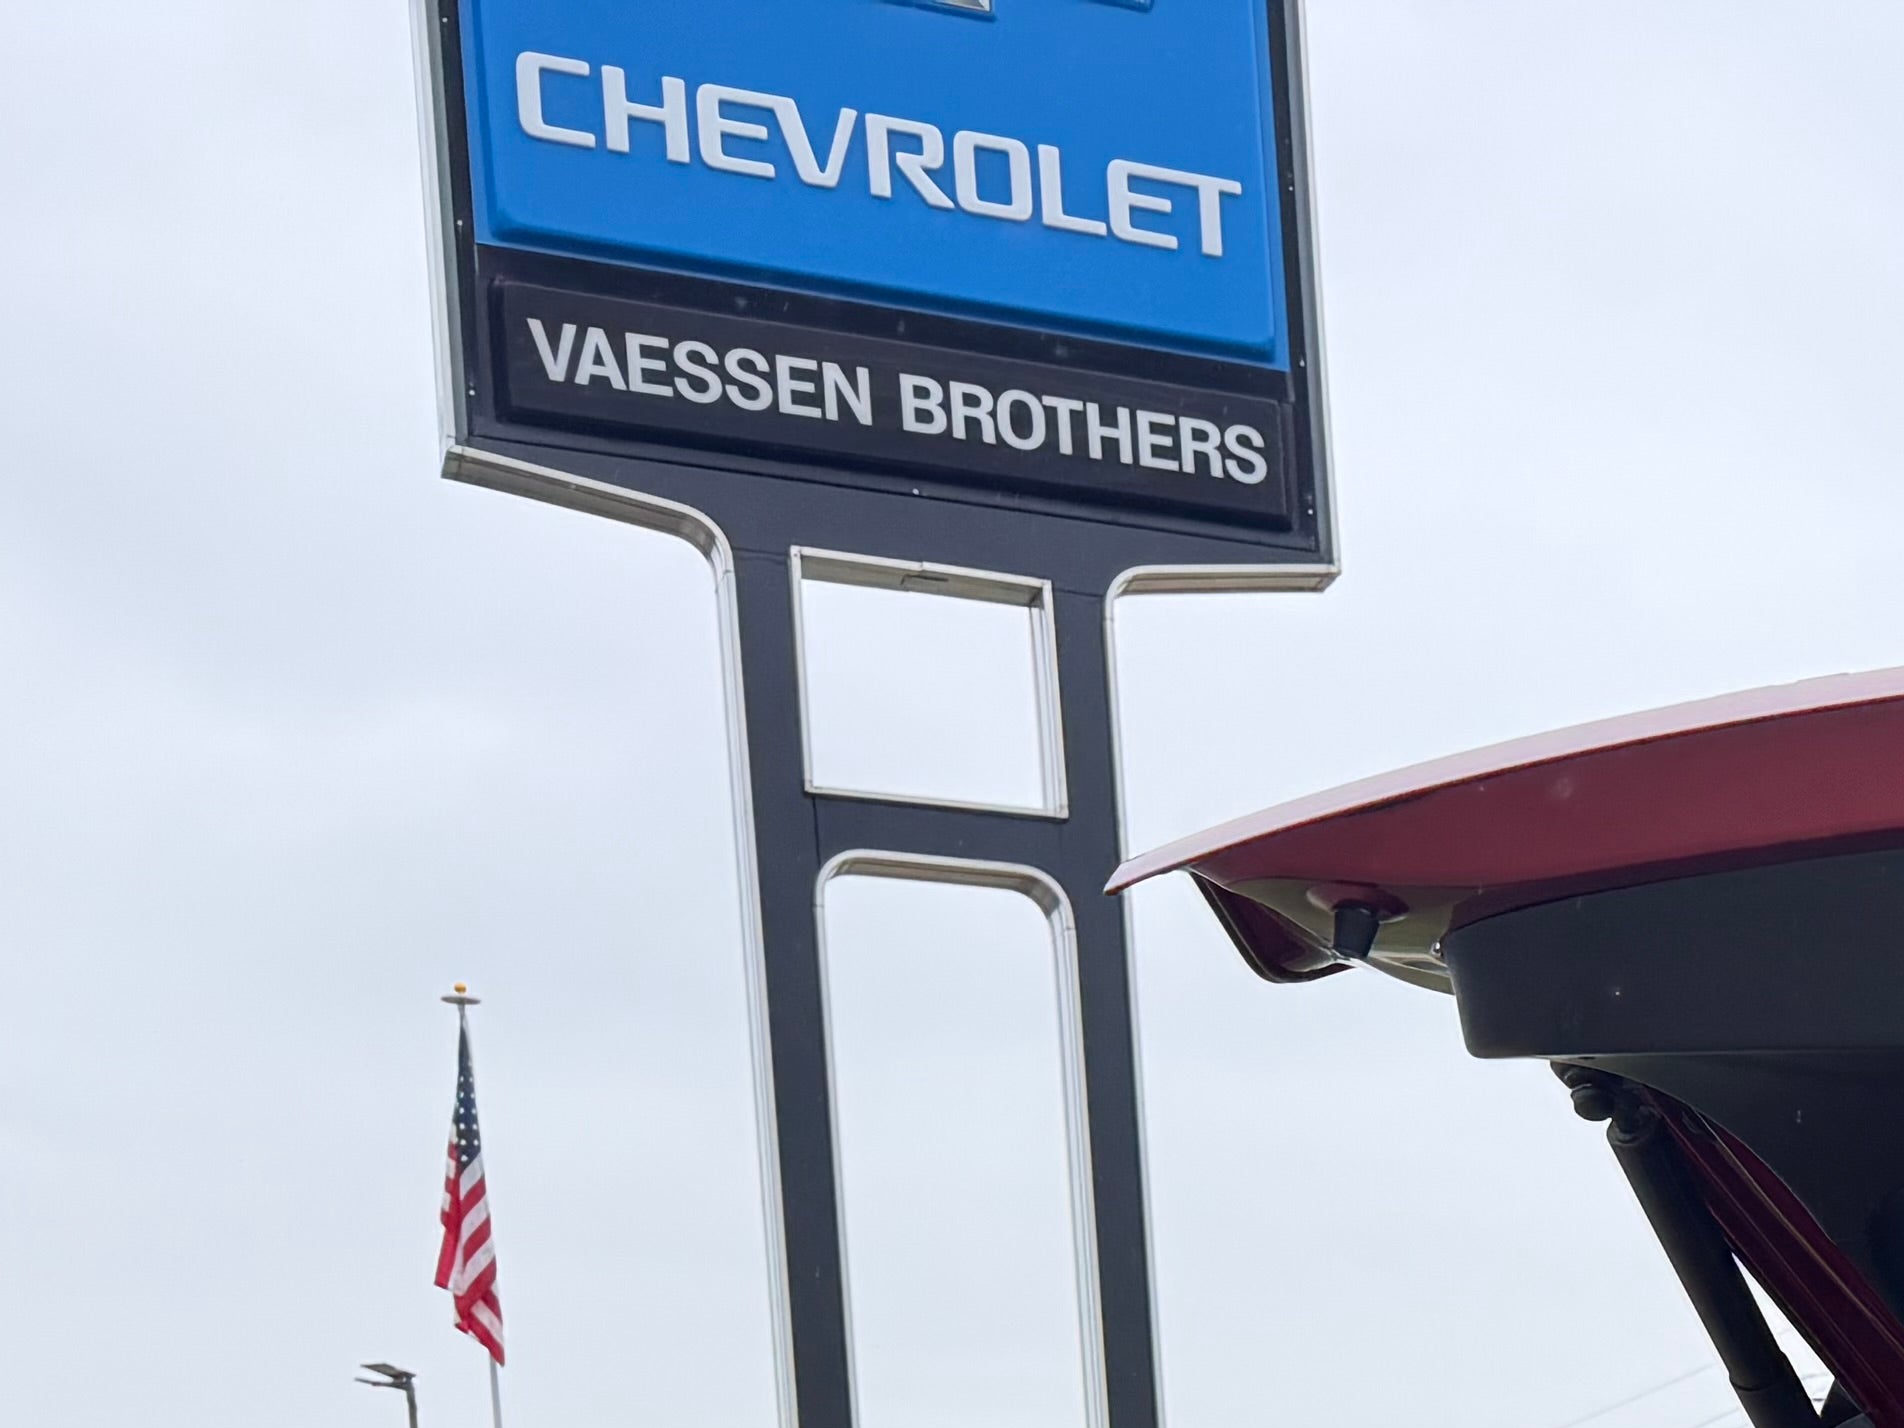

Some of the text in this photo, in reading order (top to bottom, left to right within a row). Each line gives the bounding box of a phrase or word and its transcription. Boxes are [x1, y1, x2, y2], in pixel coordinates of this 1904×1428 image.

[515, 51, 1242, 257] CHEVROLET
[526, 317, 1268, 485] VAESSEN BROTHERS
